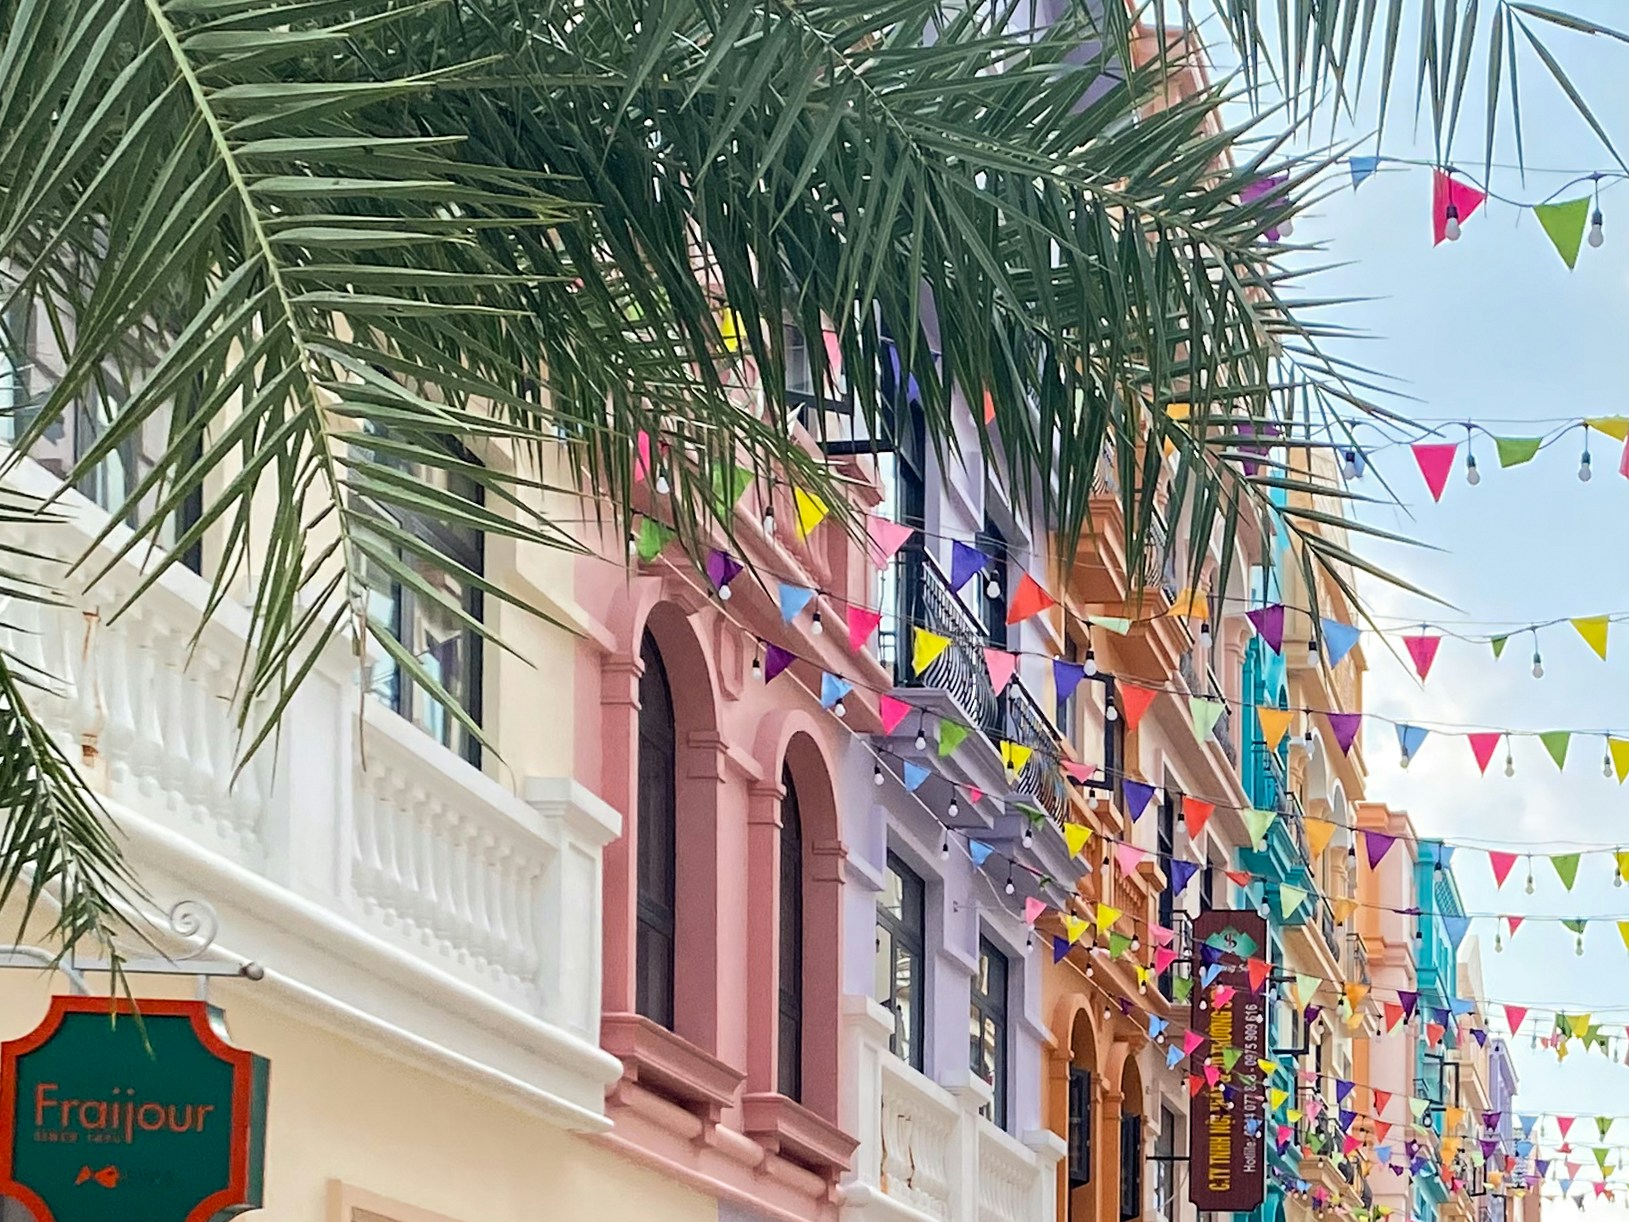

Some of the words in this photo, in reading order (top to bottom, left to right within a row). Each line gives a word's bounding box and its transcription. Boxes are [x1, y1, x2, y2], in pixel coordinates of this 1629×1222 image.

[1244, 1004, 1258, 1021] 616
[1244, 1023, 1258, 1041] 909
[1244, 1043, 1257, 1066] 0975
[34, 1083, 215, 1144] Fraijour
[1209, 1136, 1231, 1164] TNHH
